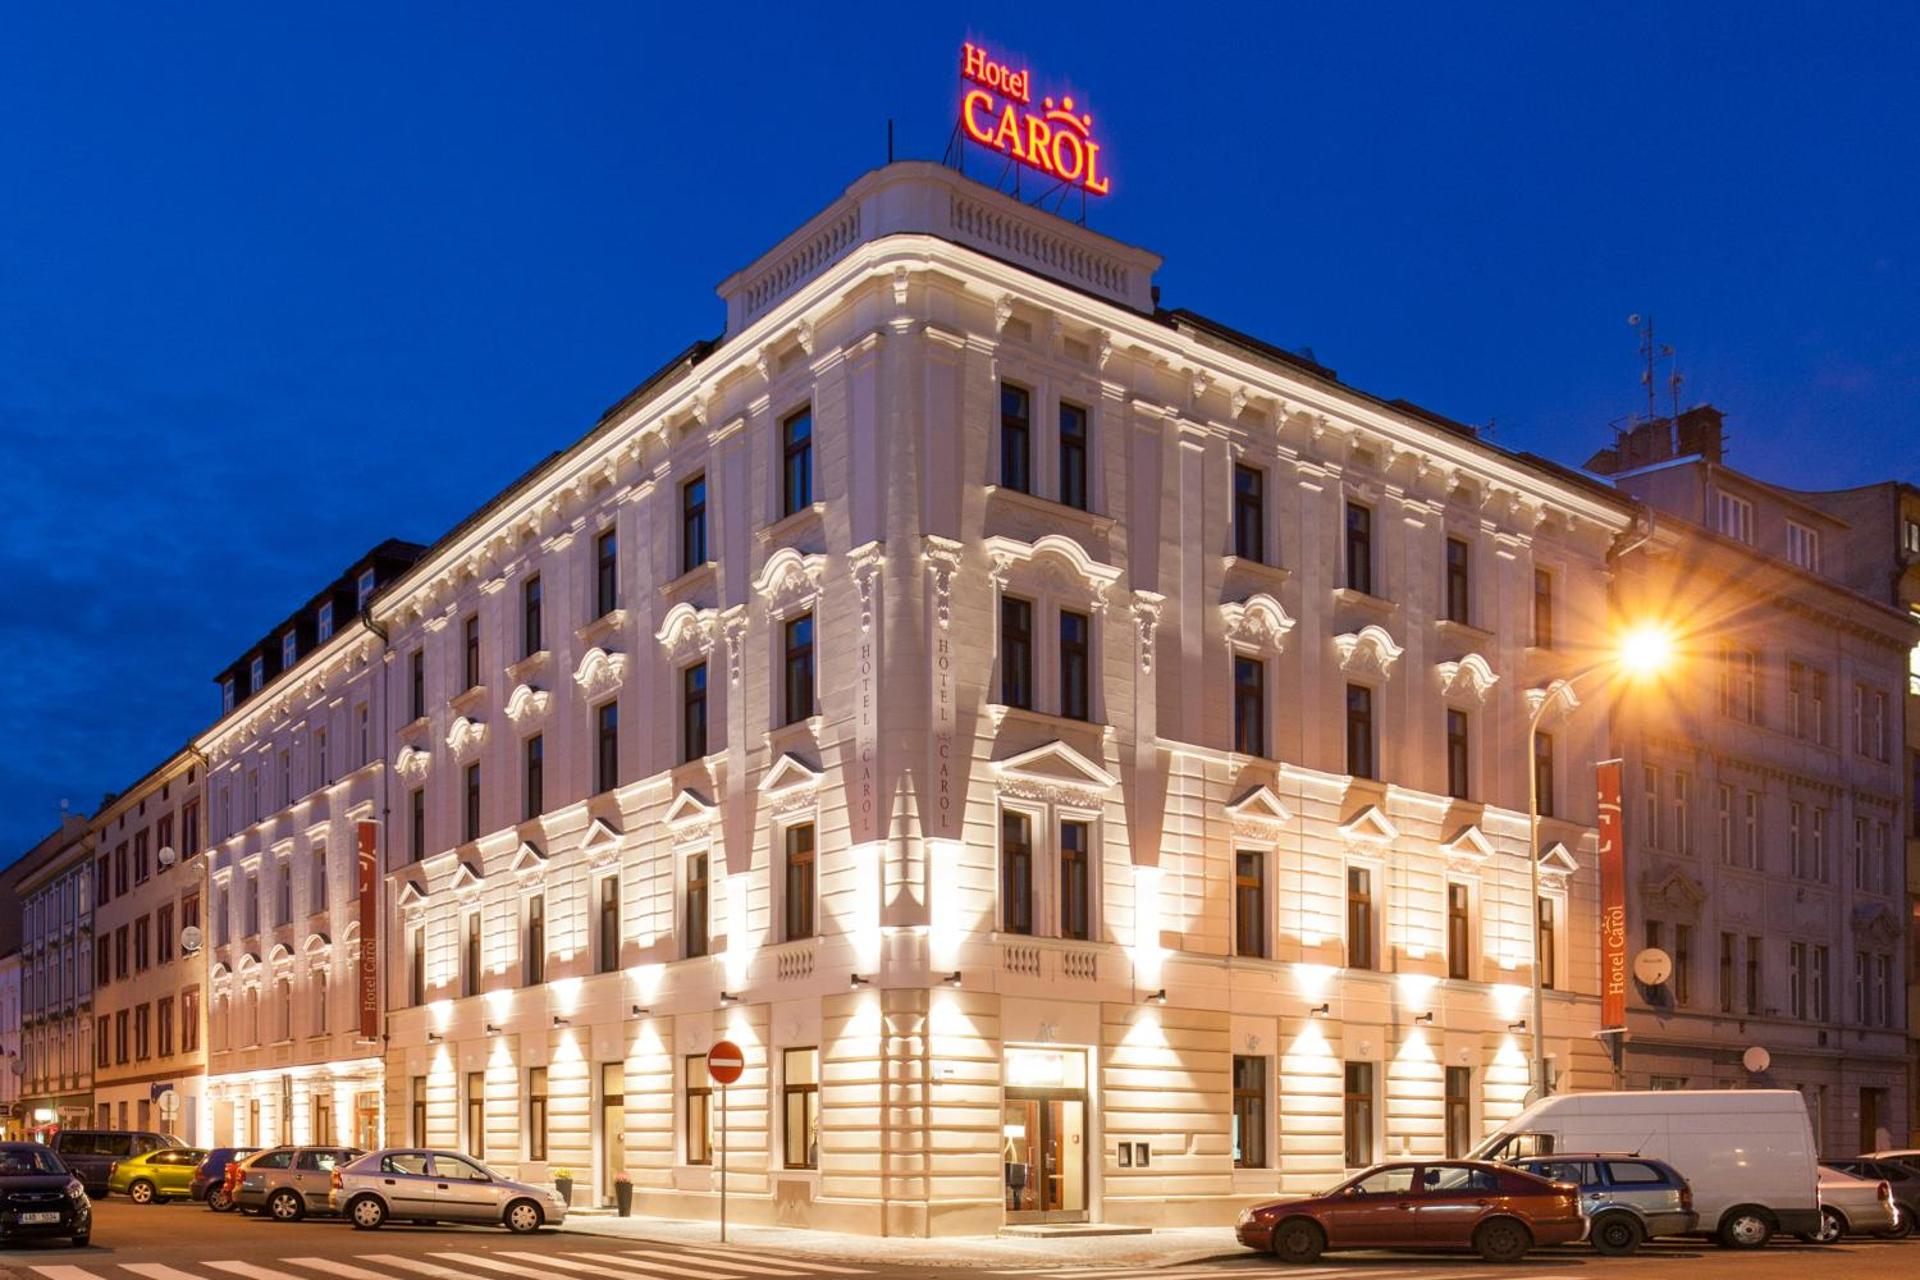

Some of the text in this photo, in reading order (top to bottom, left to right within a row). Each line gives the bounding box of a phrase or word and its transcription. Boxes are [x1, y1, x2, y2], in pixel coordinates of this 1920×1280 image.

[964, 42, 1030, 103] Hotel
[963, 90, 1109, 193] CAROL
[862, 643, 871, 832] HOTEL CAROL
[938, 638, 950, 828] HOTEL CAROL
[363, 937, 376, 1012] Hotel Carol
[1607, 904, 1624, 996] Hotel Carol
